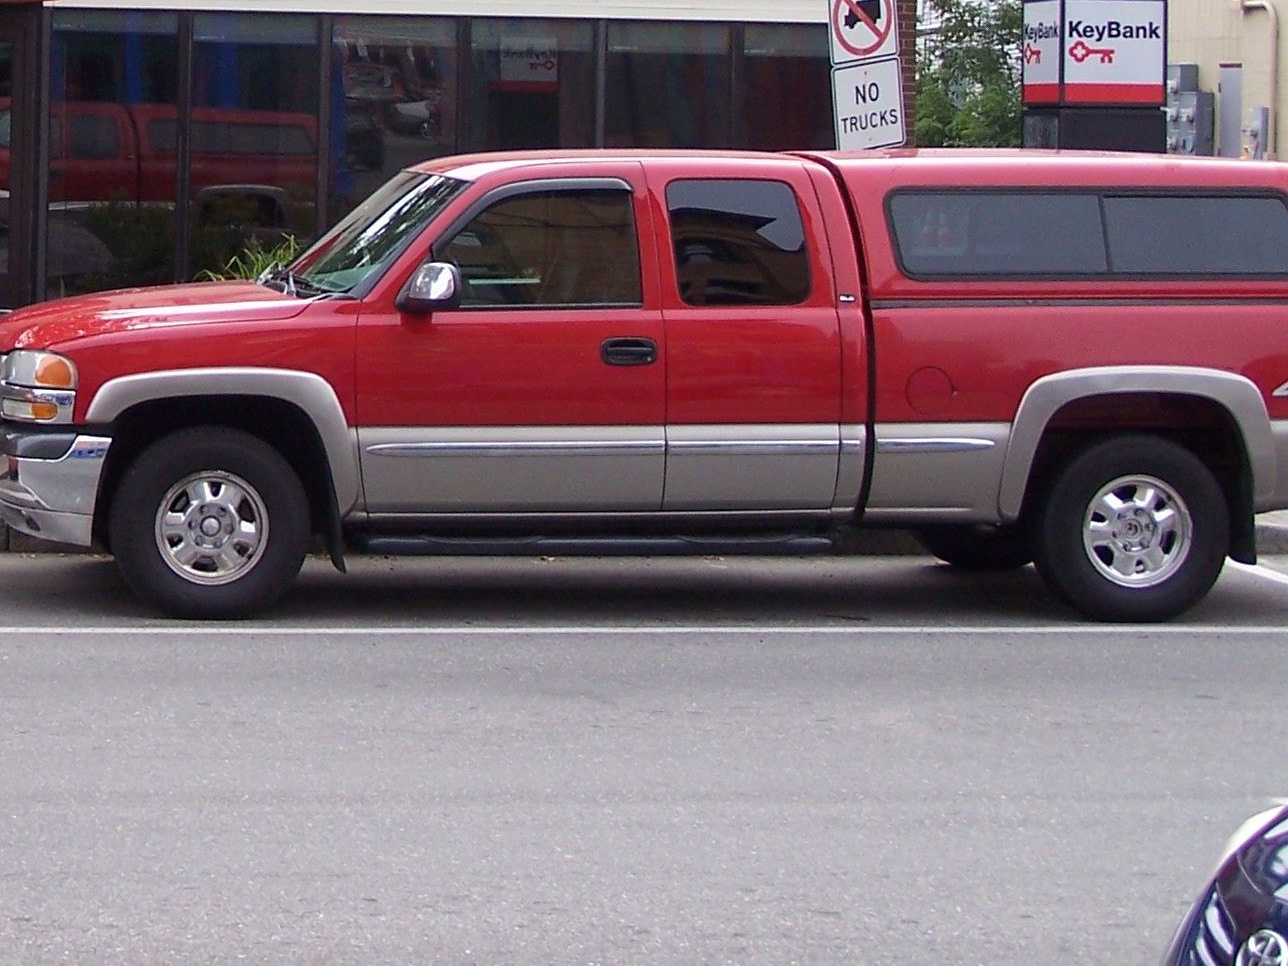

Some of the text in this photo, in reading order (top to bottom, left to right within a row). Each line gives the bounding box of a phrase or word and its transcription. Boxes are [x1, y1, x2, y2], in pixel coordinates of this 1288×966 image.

[1024, 21, 1060, 43] KeyBank
[1068, 20, 1161, 42] KeyBank
[855, 82, 880, 105] NO
[841, 108, 899, 134] TRUCKS
